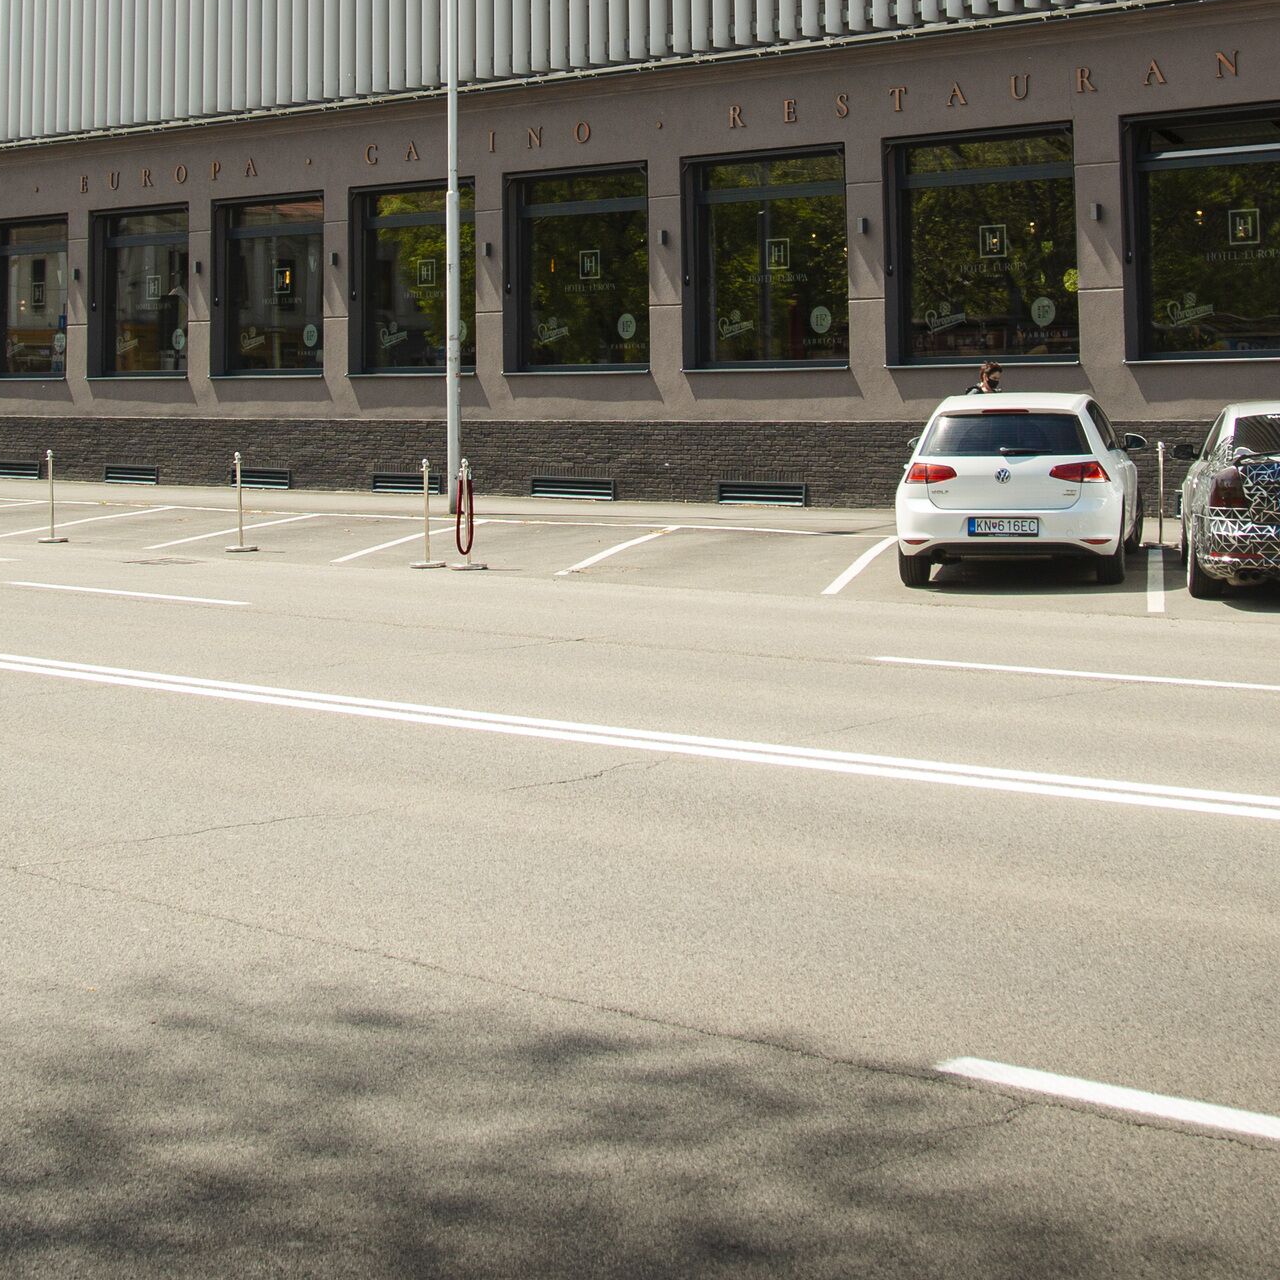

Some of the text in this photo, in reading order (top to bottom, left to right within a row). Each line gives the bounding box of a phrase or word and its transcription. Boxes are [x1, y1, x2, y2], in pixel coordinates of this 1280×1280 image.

[79, 157, 258, 194] EUROPA
[364, 120, 591, 166] CAINO
[1206, 251, 1240, 262] HOTEL
